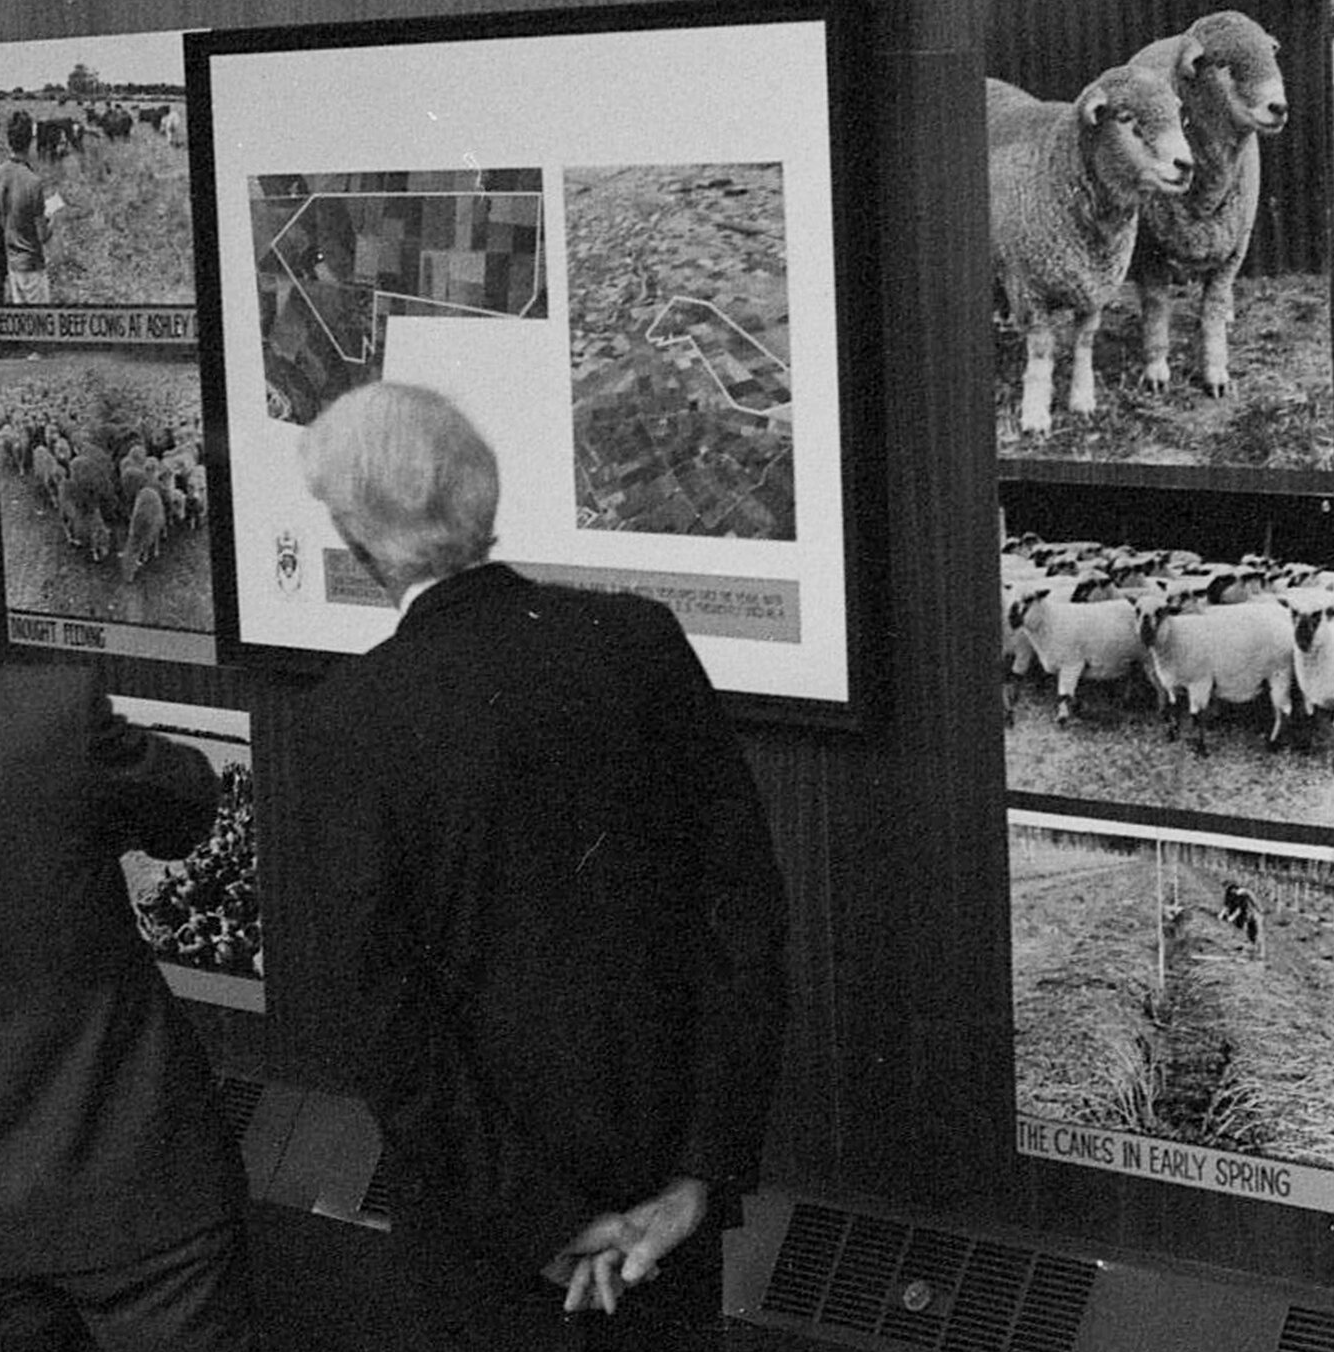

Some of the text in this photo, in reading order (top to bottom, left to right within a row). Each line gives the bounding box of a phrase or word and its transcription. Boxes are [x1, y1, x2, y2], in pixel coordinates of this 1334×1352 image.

[1017, 1120, 1291, 1197] THE CANES IN EARLY SPRING
